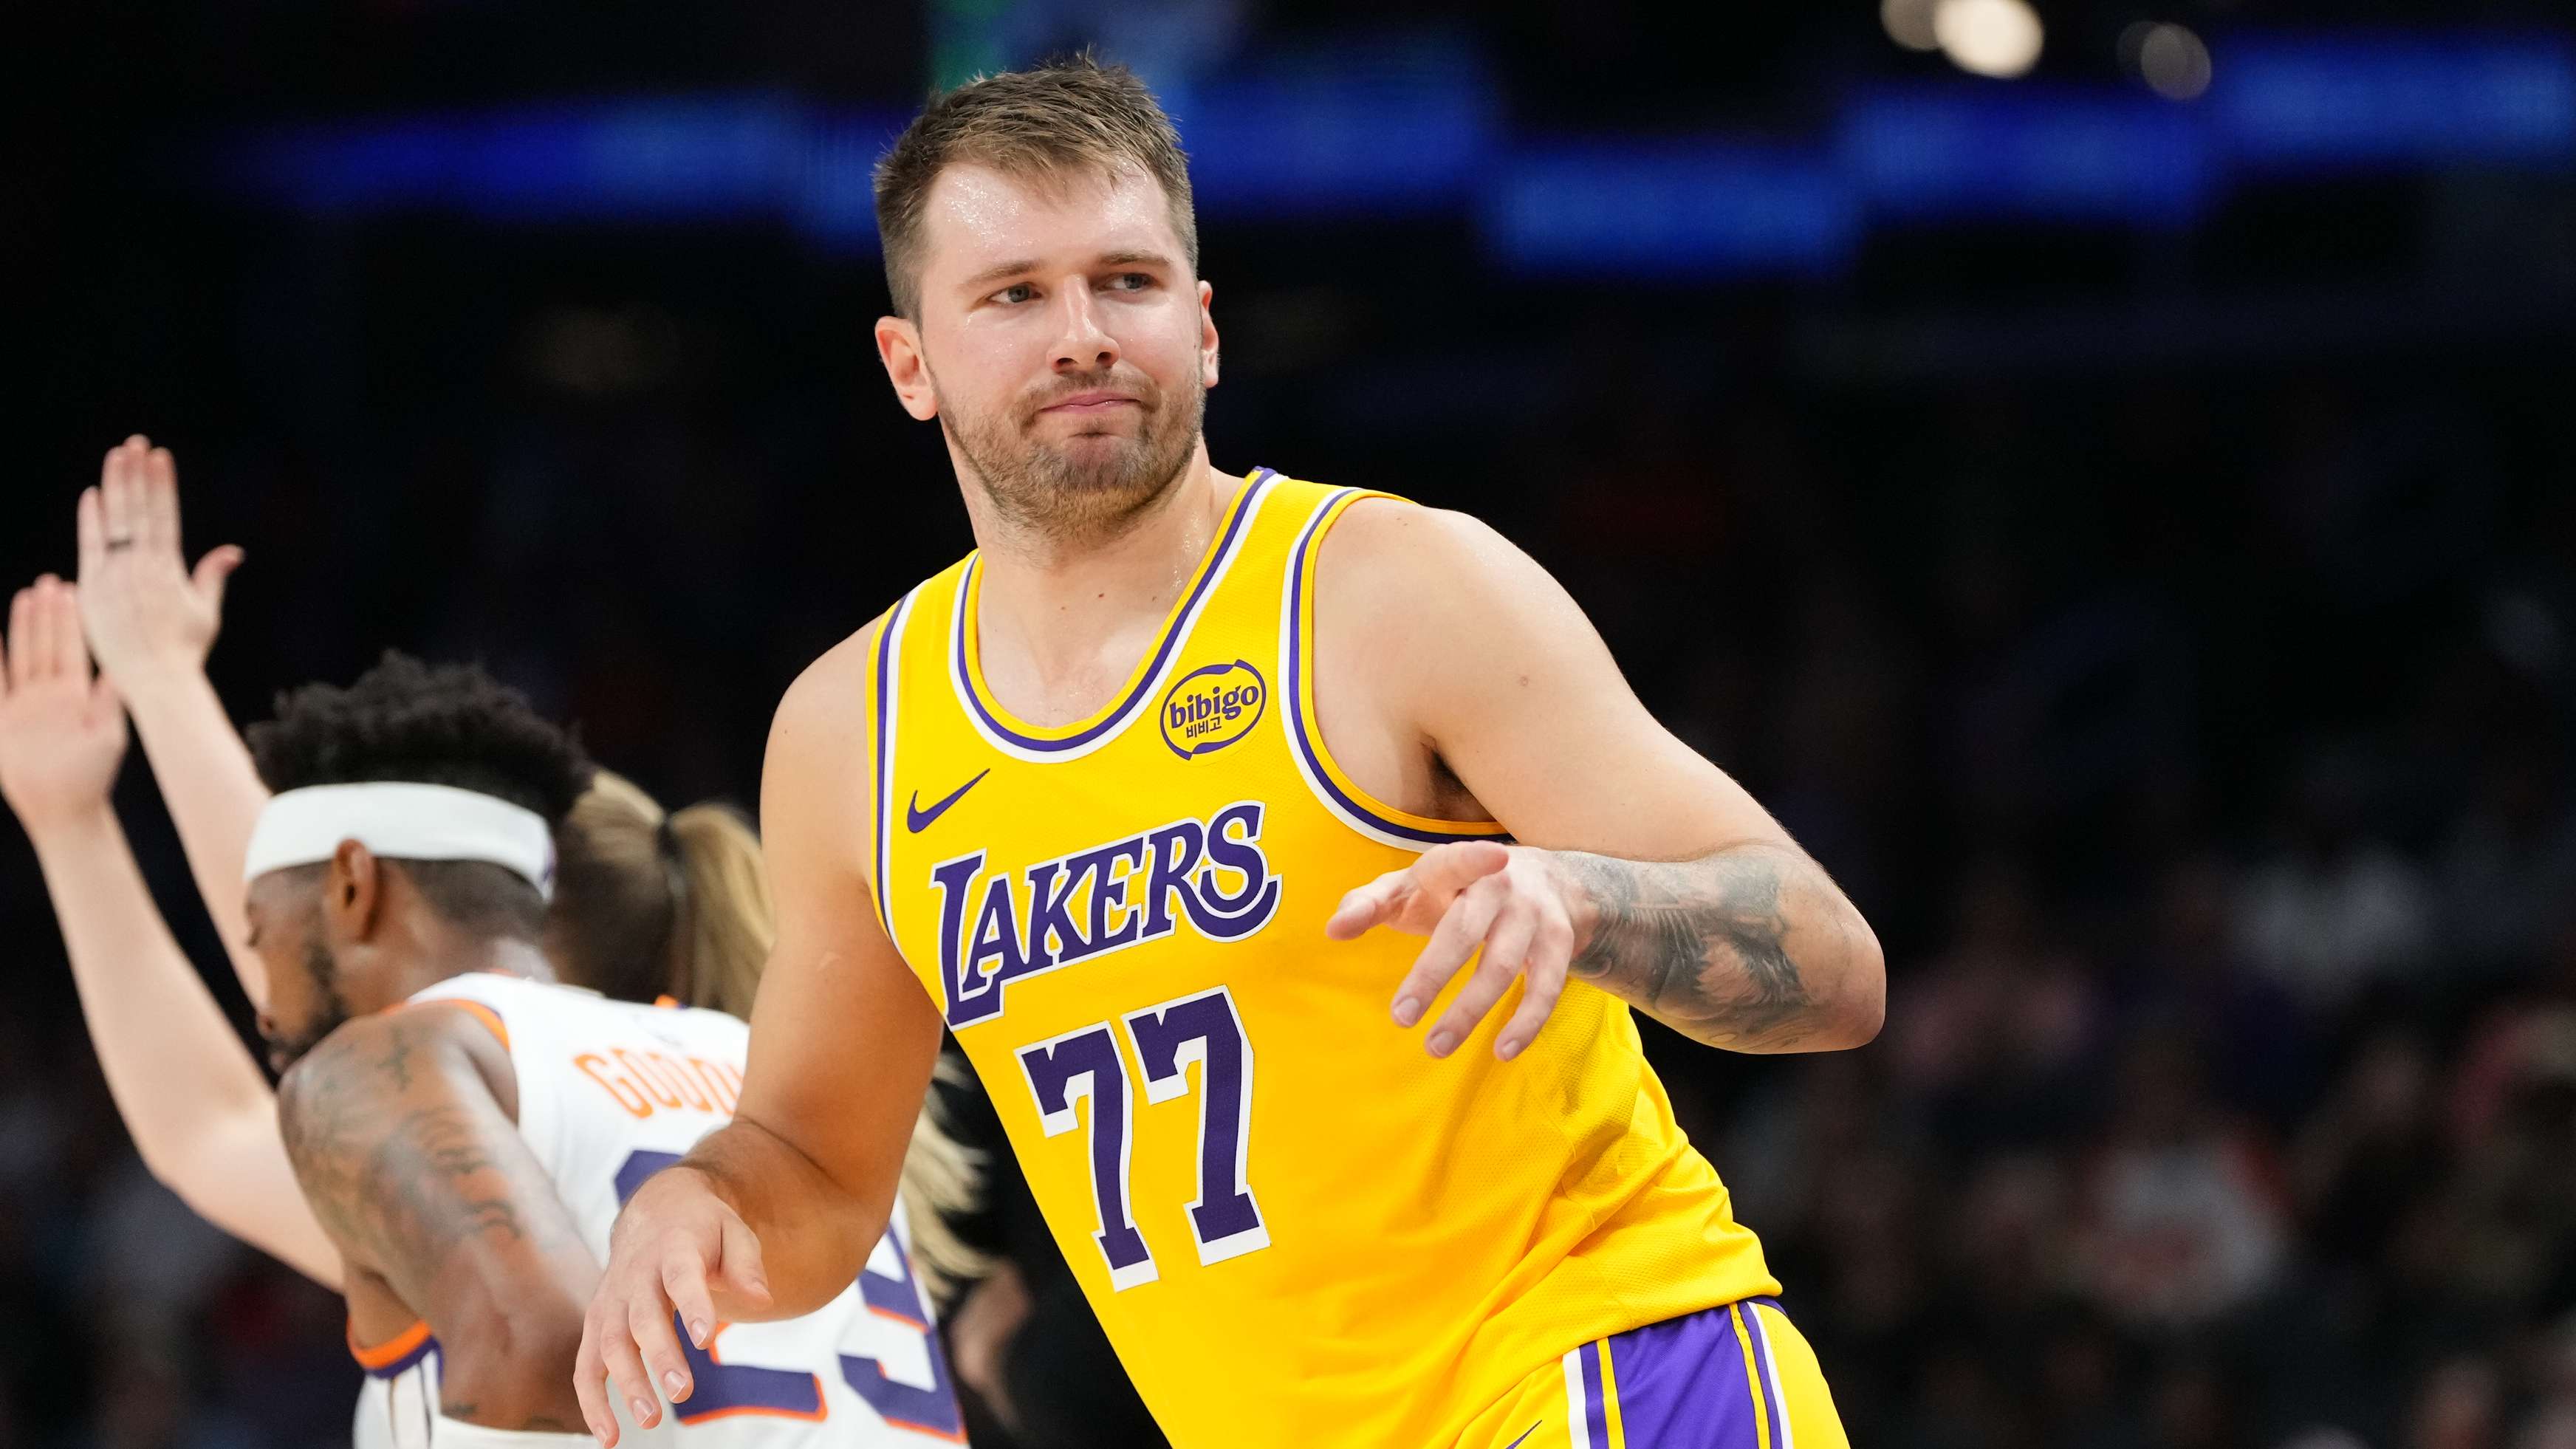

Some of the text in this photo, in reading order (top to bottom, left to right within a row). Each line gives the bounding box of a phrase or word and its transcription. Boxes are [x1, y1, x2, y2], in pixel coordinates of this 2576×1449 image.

[1169, 685, 1259, 729] bibigo
[1186, 716, 1222, 739] 비비고
[929, 800, 1284, 1032] LAKERS
[573, 1046, 744, 1119] GOOD
[1013, 984, 1272, 1292] 77
